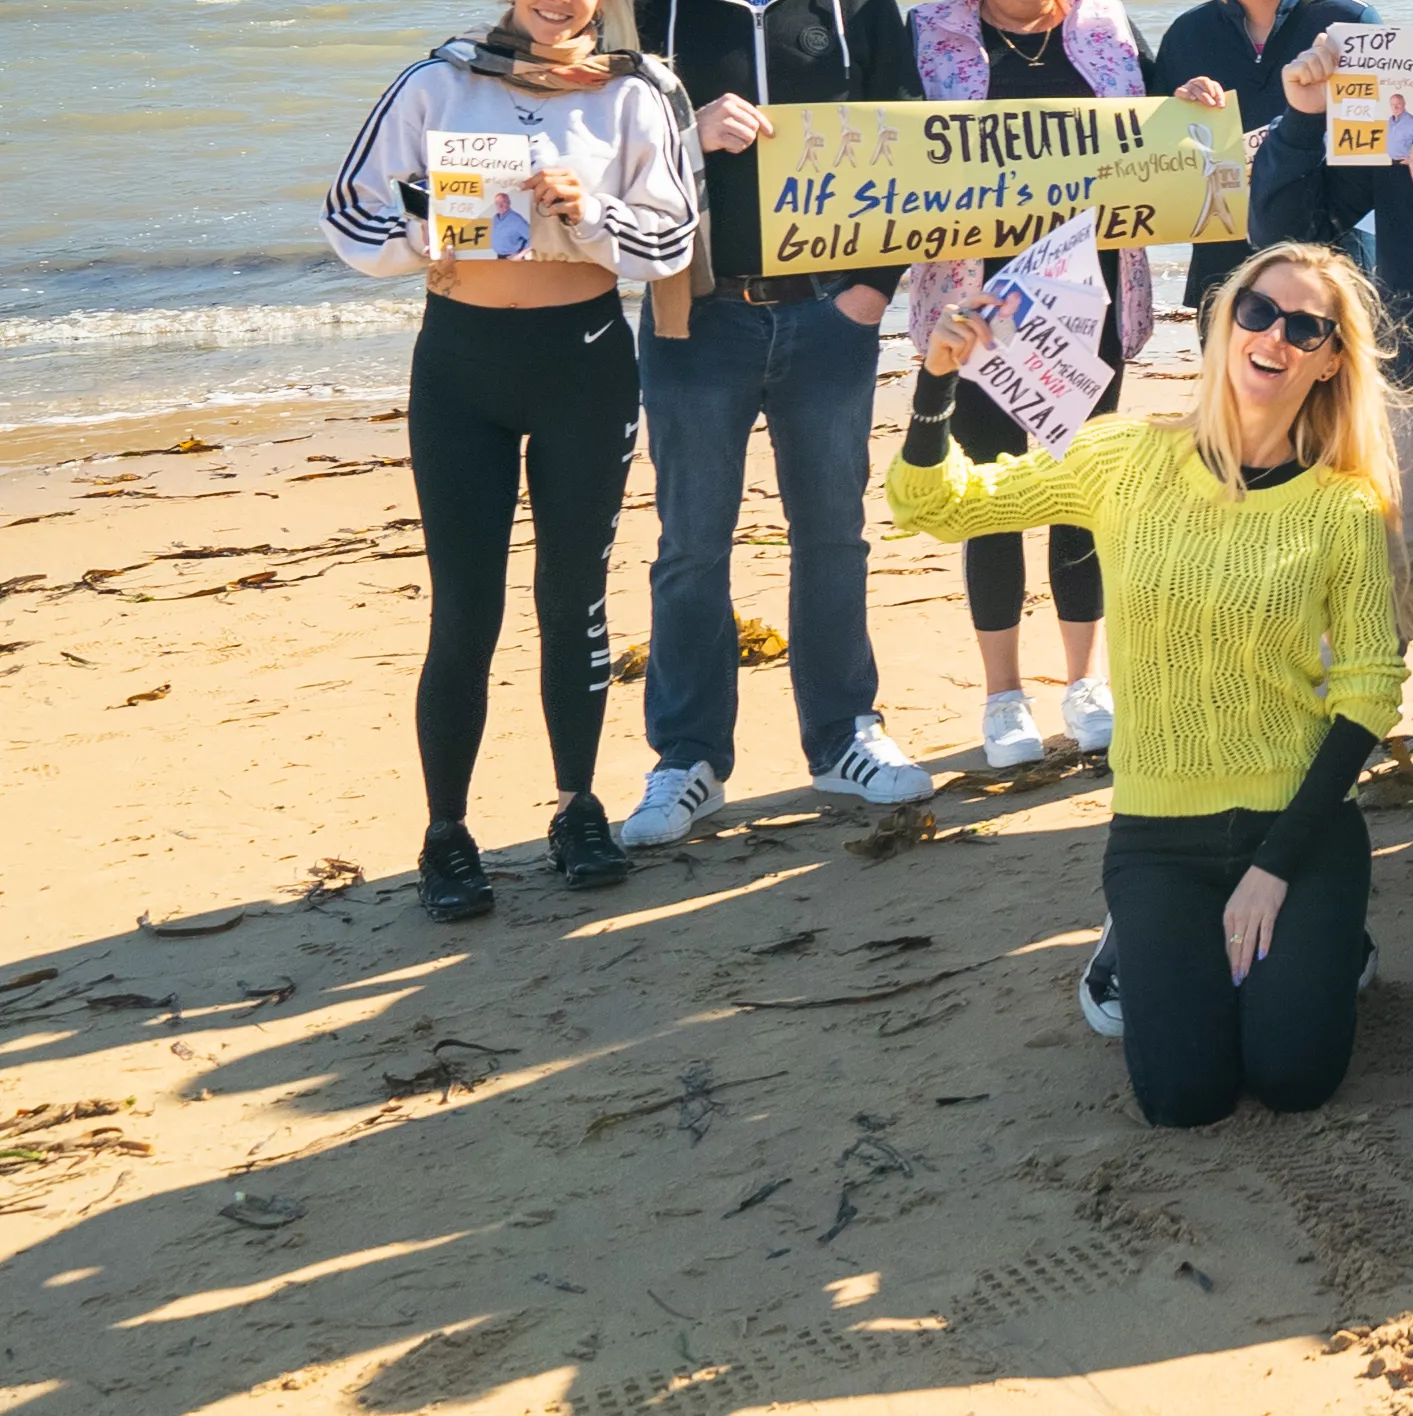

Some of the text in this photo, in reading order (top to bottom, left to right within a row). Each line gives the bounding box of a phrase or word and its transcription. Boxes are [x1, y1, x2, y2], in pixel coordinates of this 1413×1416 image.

[1343, 32, 1397, 54] STOP
[1336, 83, 1375, 97] VOTE
[1346, 105, 1371, 117] FOR
[444, 137, 498, 154] STOP
[924, 107, 1145, 168] STREUTH !!
[1338, 128, 1384, 151] ALF
[440, 155, 525, 172] BLUDGING!
[1097, 150, 1199, 183] #Ray4Gold
[439, 180, 480, 195] VOTE
[773, 170, 1097, 219] Alf Stewart's our
[441, 225, 489, 247] ALF
[777, 222, 862, 263] Gold
[879, 218, 983, 259] Logie
[1016, 315, 1069, 360] RAY
[1052, 358, 1102, 401] MEAGHER
[1023, 350, 1043, 372] TO
[978, 354, 1070, 445] BONZA !!
